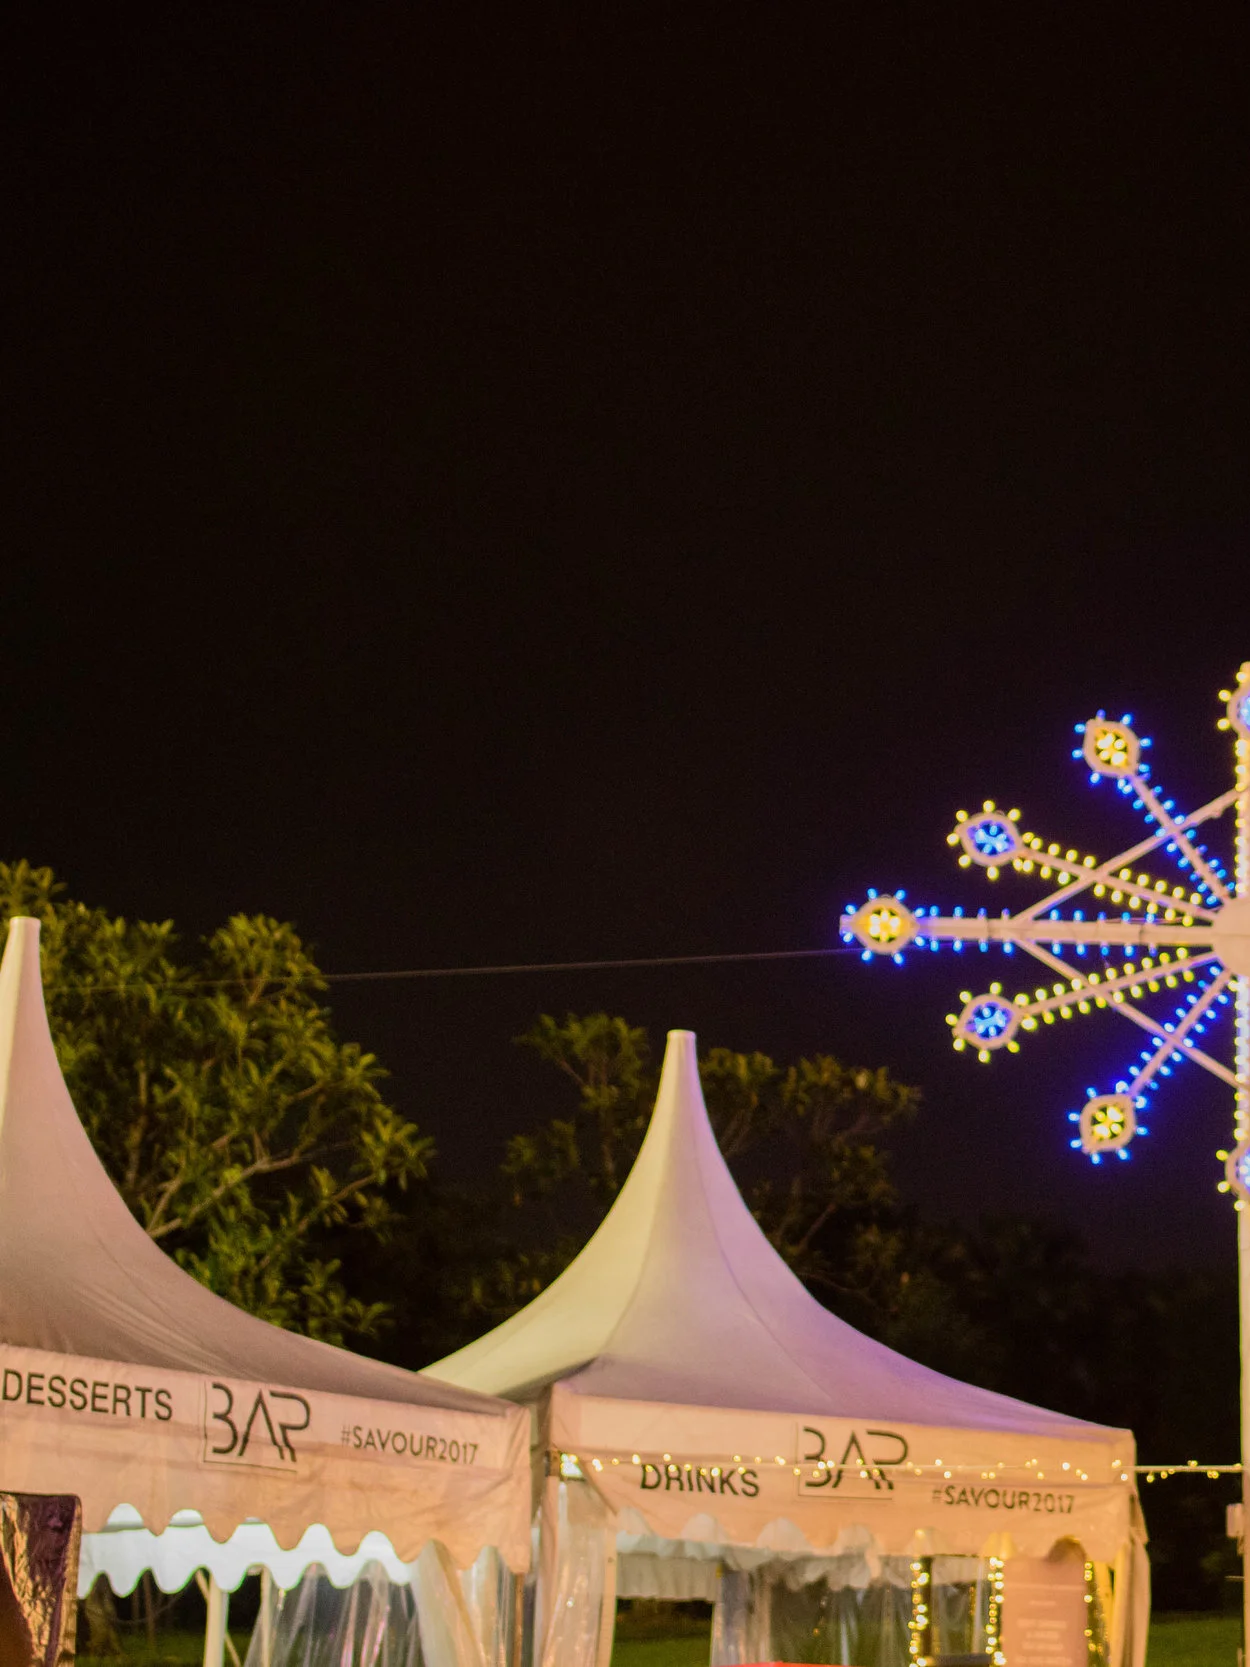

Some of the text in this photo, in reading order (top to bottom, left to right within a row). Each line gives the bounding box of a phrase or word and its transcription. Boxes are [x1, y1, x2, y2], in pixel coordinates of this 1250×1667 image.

[1, 1368, 174, 1422] DESSERTS
[211, 1381, 312, 1463] BAR
[341, 1424, 480, 1465] #SAVOUR2017
[639, 1463, 761, 1498] DRINKS
[801, 1426, 909, 1491] BAR
[932, 1484, 1076, 1515] #SAVOUR2017
